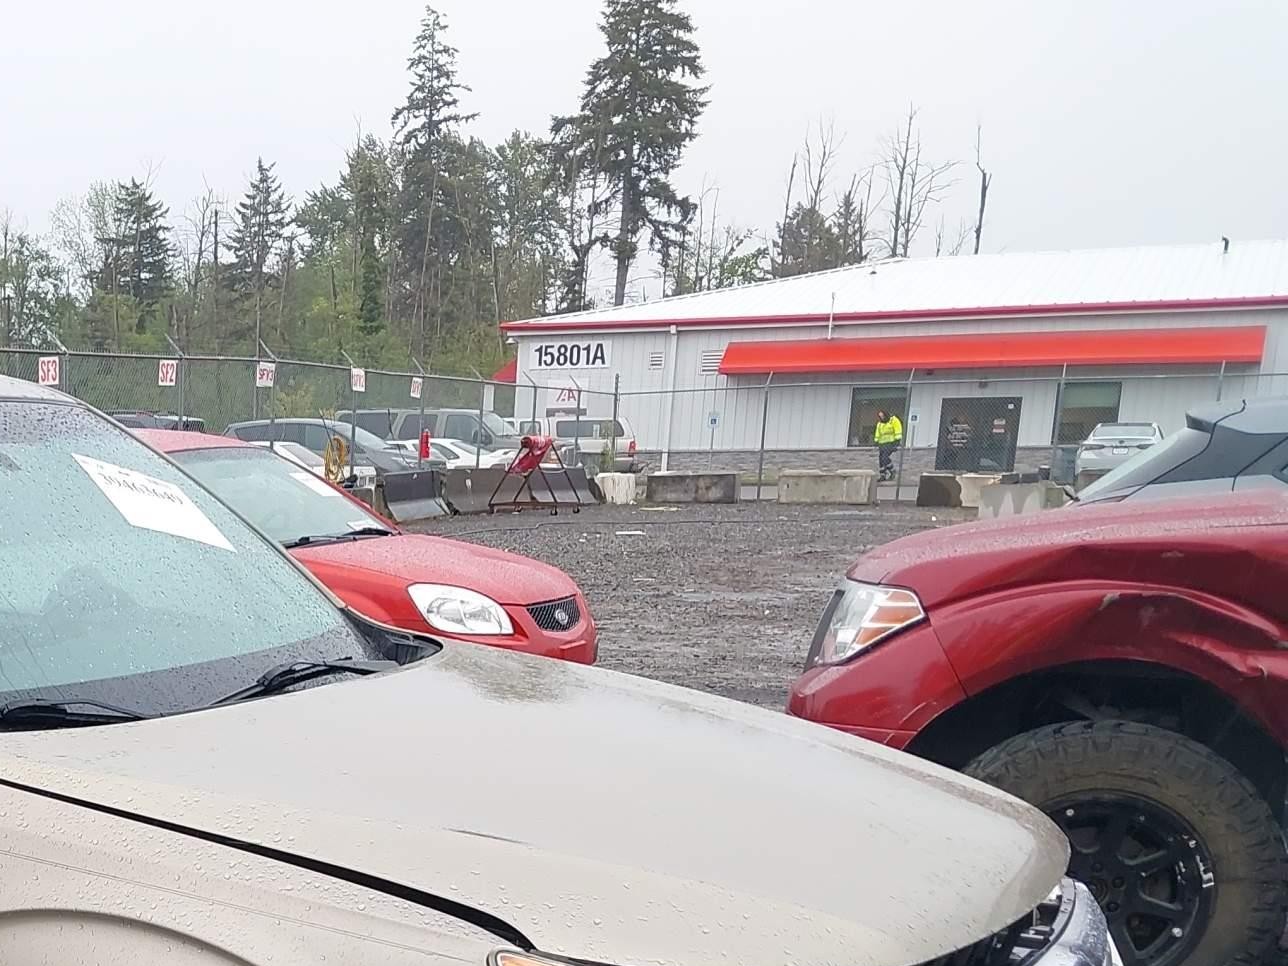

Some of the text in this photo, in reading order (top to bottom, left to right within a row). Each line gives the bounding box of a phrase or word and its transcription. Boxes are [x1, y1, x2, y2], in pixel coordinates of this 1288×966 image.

[534, 342, 606, 367] 15801A
[40, 359, 58, 382] SF3
[160, 362, 175, 383] SF2
